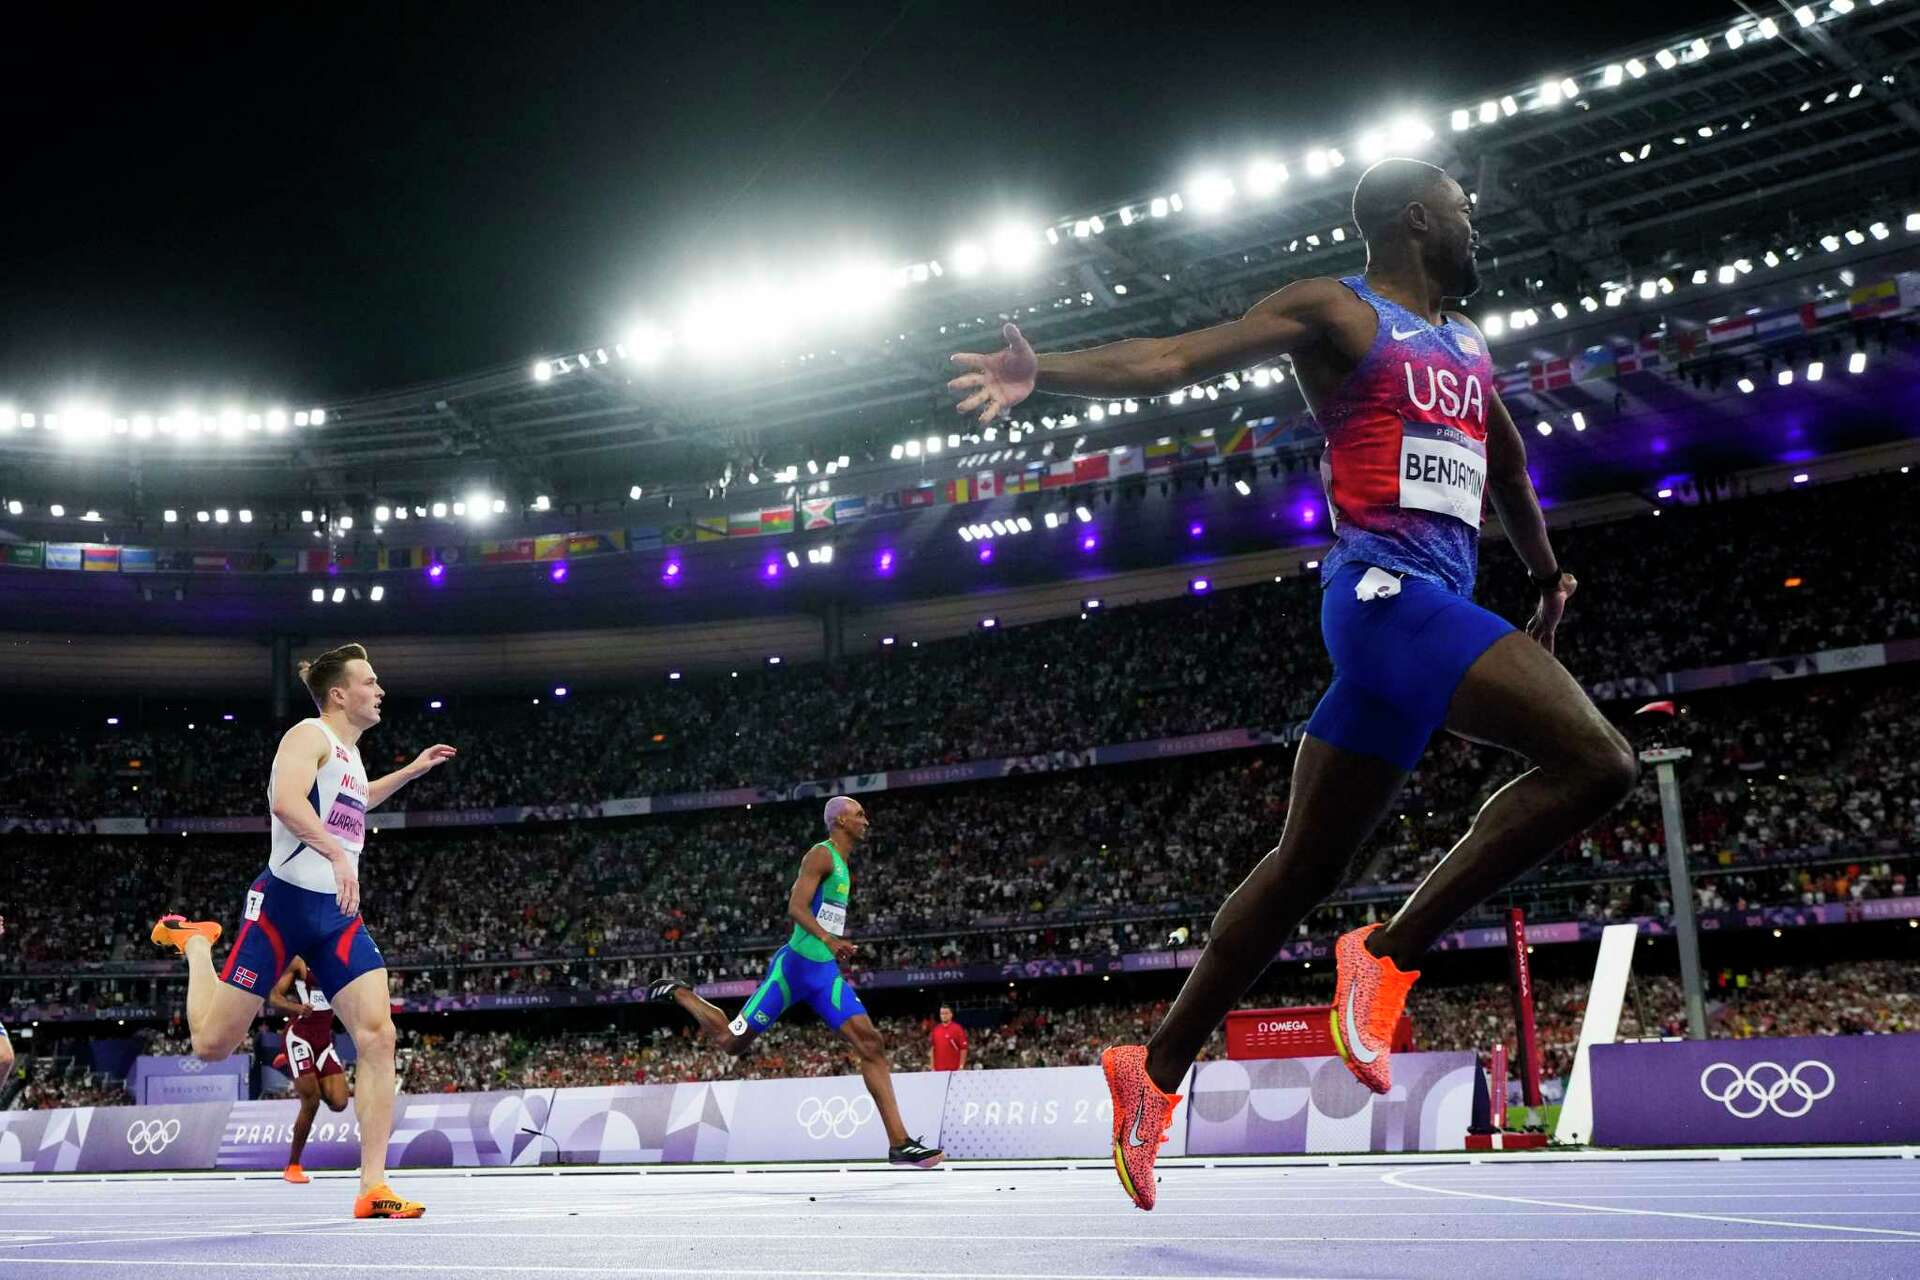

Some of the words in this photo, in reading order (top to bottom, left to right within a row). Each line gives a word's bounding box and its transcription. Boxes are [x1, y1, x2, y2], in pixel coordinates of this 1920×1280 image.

[1405, 362, 1483, 423] USA
[1405, 453, 1483, 500] BENJAMIN
[1518, 941, 1528, 997] OMEGA
[735, 1020, 743, 1032] 3
[1269, 1020, 1309, 1032] OMEGA
[961, 1100, 1059, 1126] PARIS
[1073, 1099, 1114, 1124] 20
[233, 1123, 295, 1145] PARIS
[371, 1200, 402, 1212] NITRO
